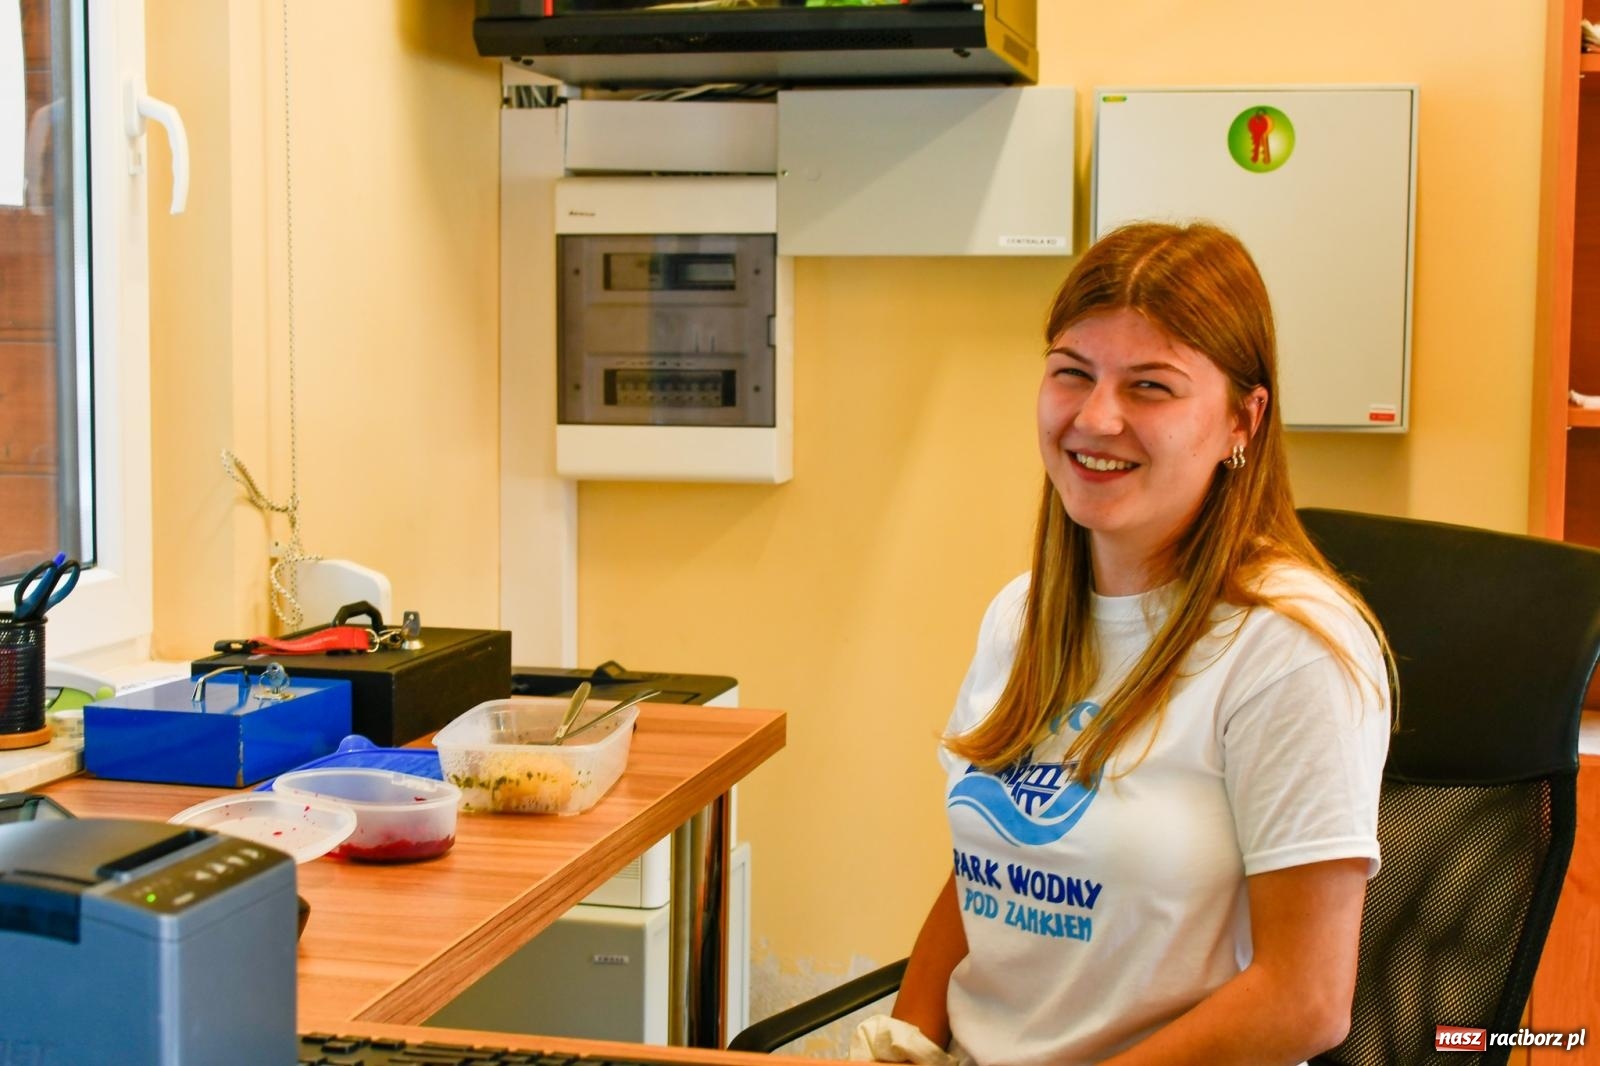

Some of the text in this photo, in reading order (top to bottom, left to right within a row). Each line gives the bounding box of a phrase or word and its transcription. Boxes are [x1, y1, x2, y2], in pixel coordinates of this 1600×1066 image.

[953, 848, 1102, 910] PARK WODNY
[964, 888, 1092, 942] POD ZAMKIEM
